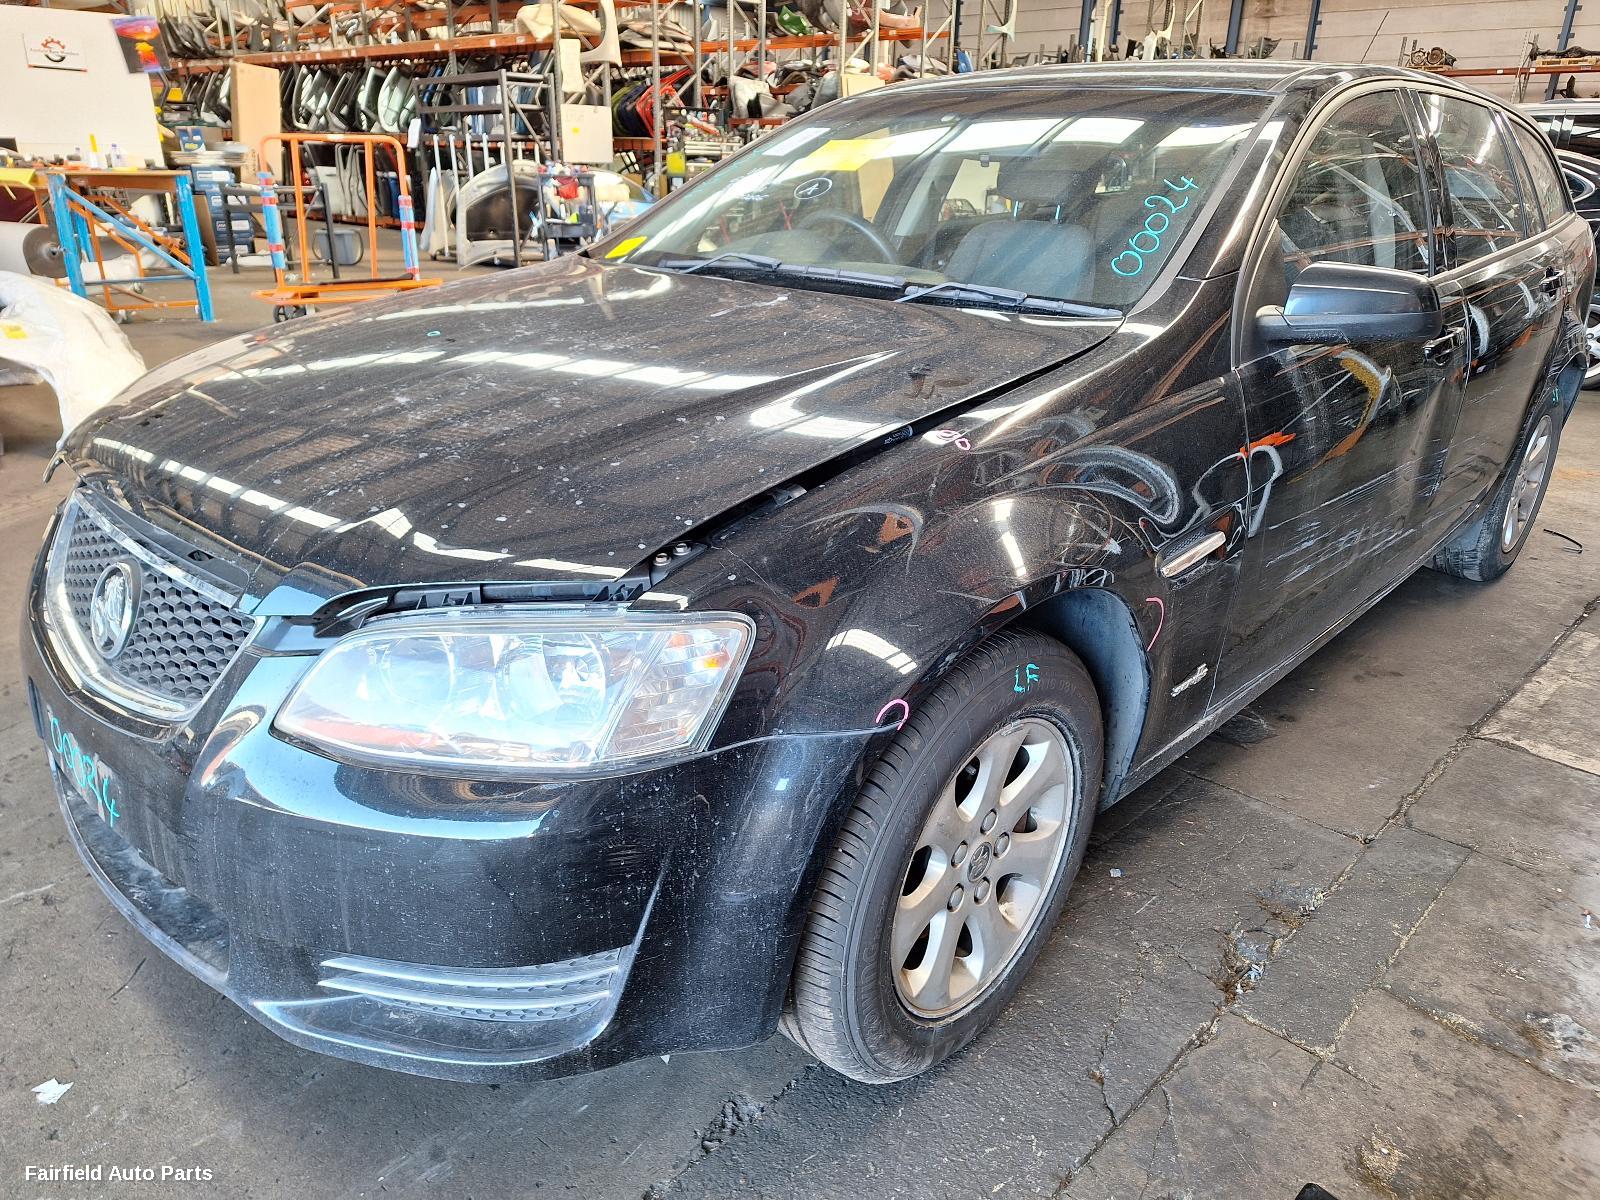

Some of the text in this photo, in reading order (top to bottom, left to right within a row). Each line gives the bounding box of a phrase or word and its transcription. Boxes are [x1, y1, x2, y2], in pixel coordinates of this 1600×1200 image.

[1111, 175, 1199, 276] 00024
[1013, 663, 1040, 692] LF
[51, 717, 120, 828] 00024
